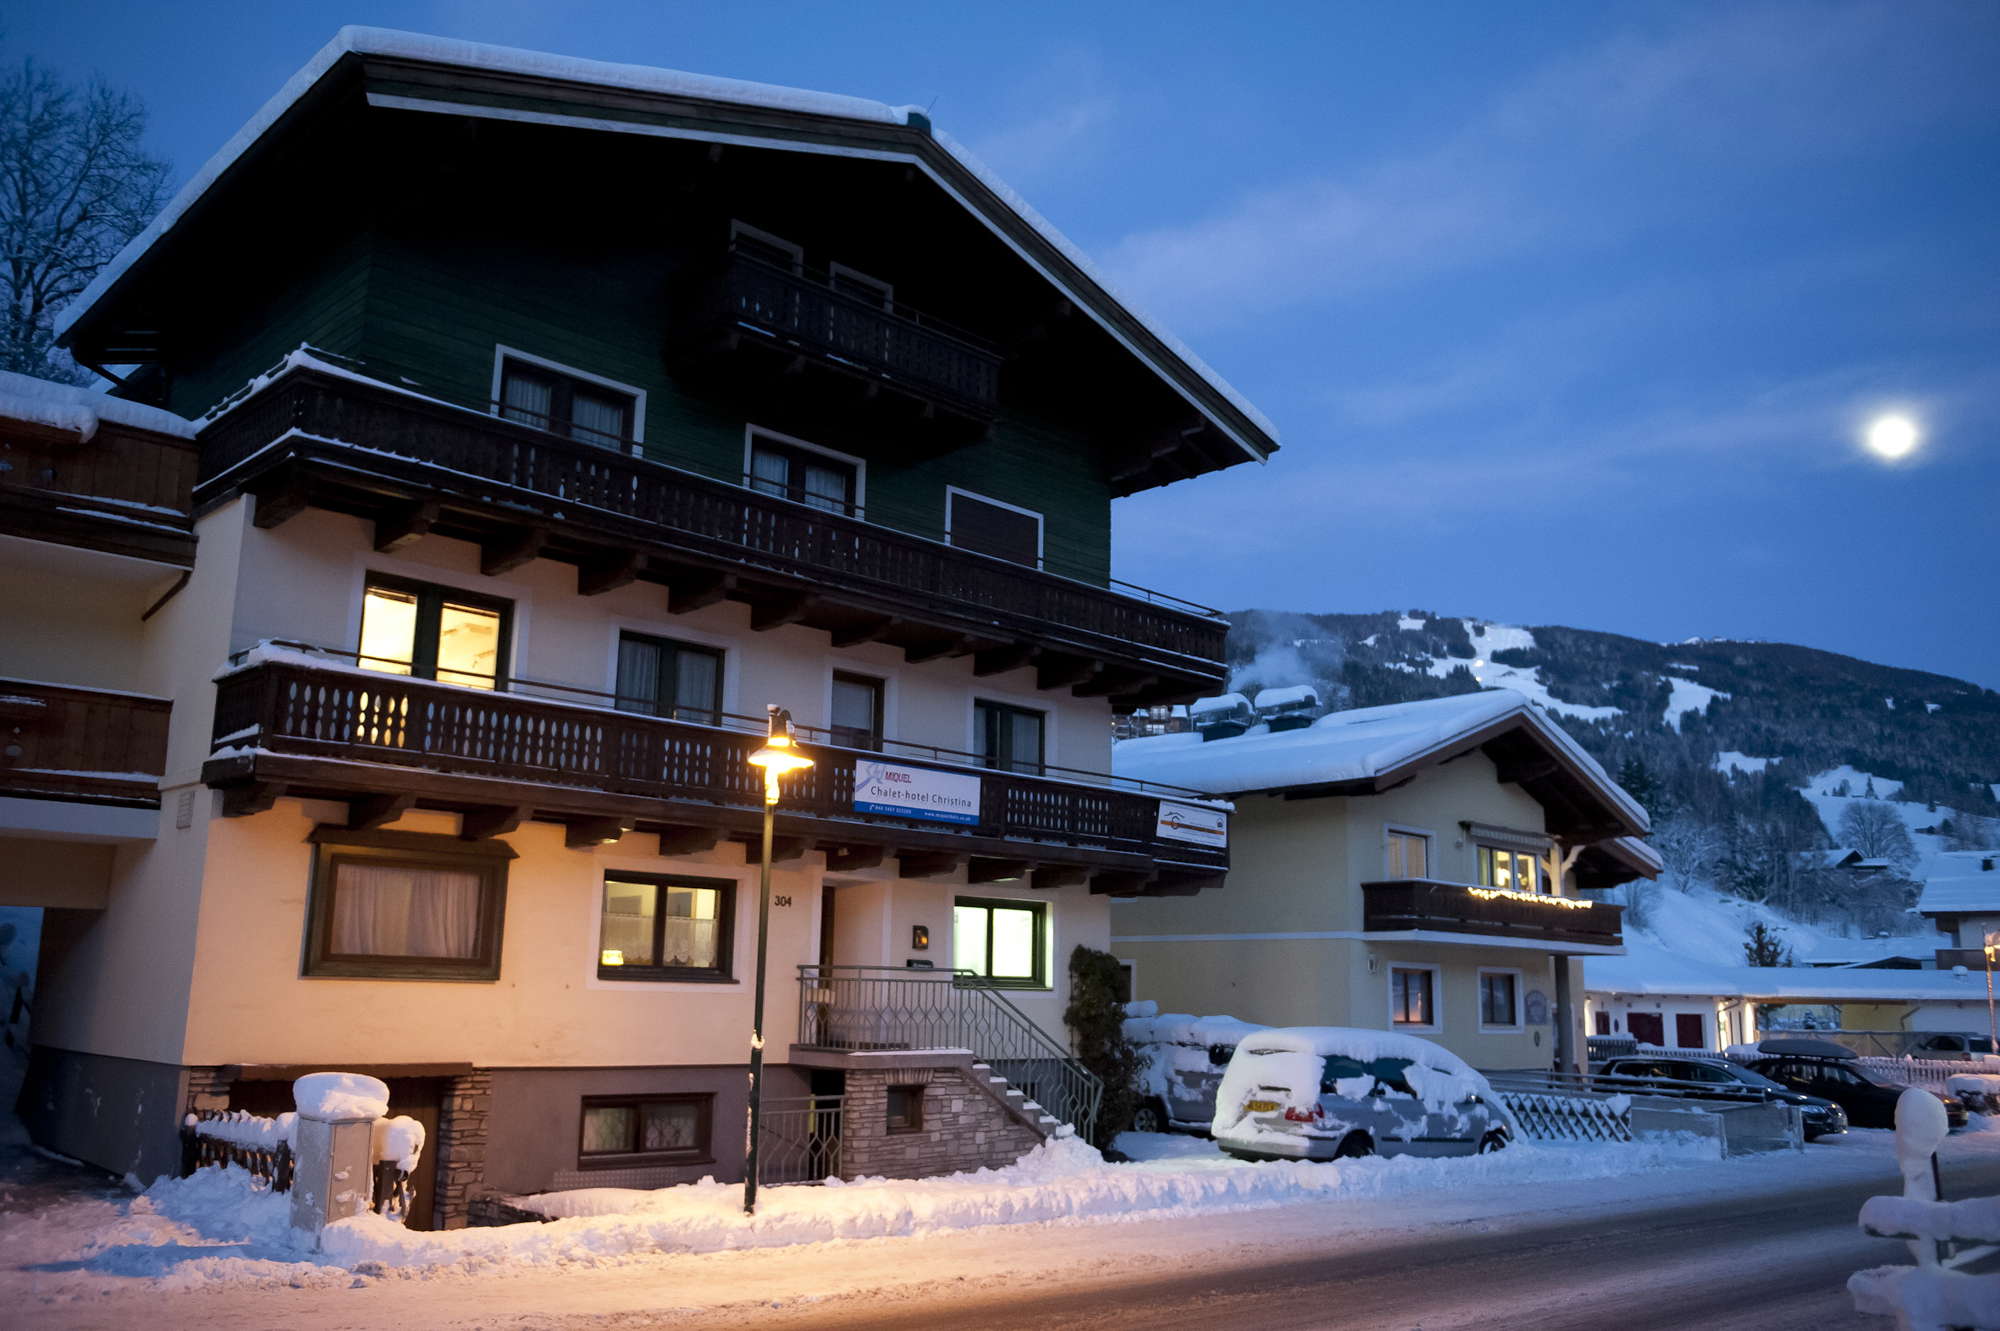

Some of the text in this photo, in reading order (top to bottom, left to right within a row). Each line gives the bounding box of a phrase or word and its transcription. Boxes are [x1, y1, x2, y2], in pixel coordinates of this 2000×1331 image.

[885, 771, 912, 783] MIQUEL
[870, 786, 972, 807] Chalet-hotel Christina
[774, 895, 792, 907] 304
